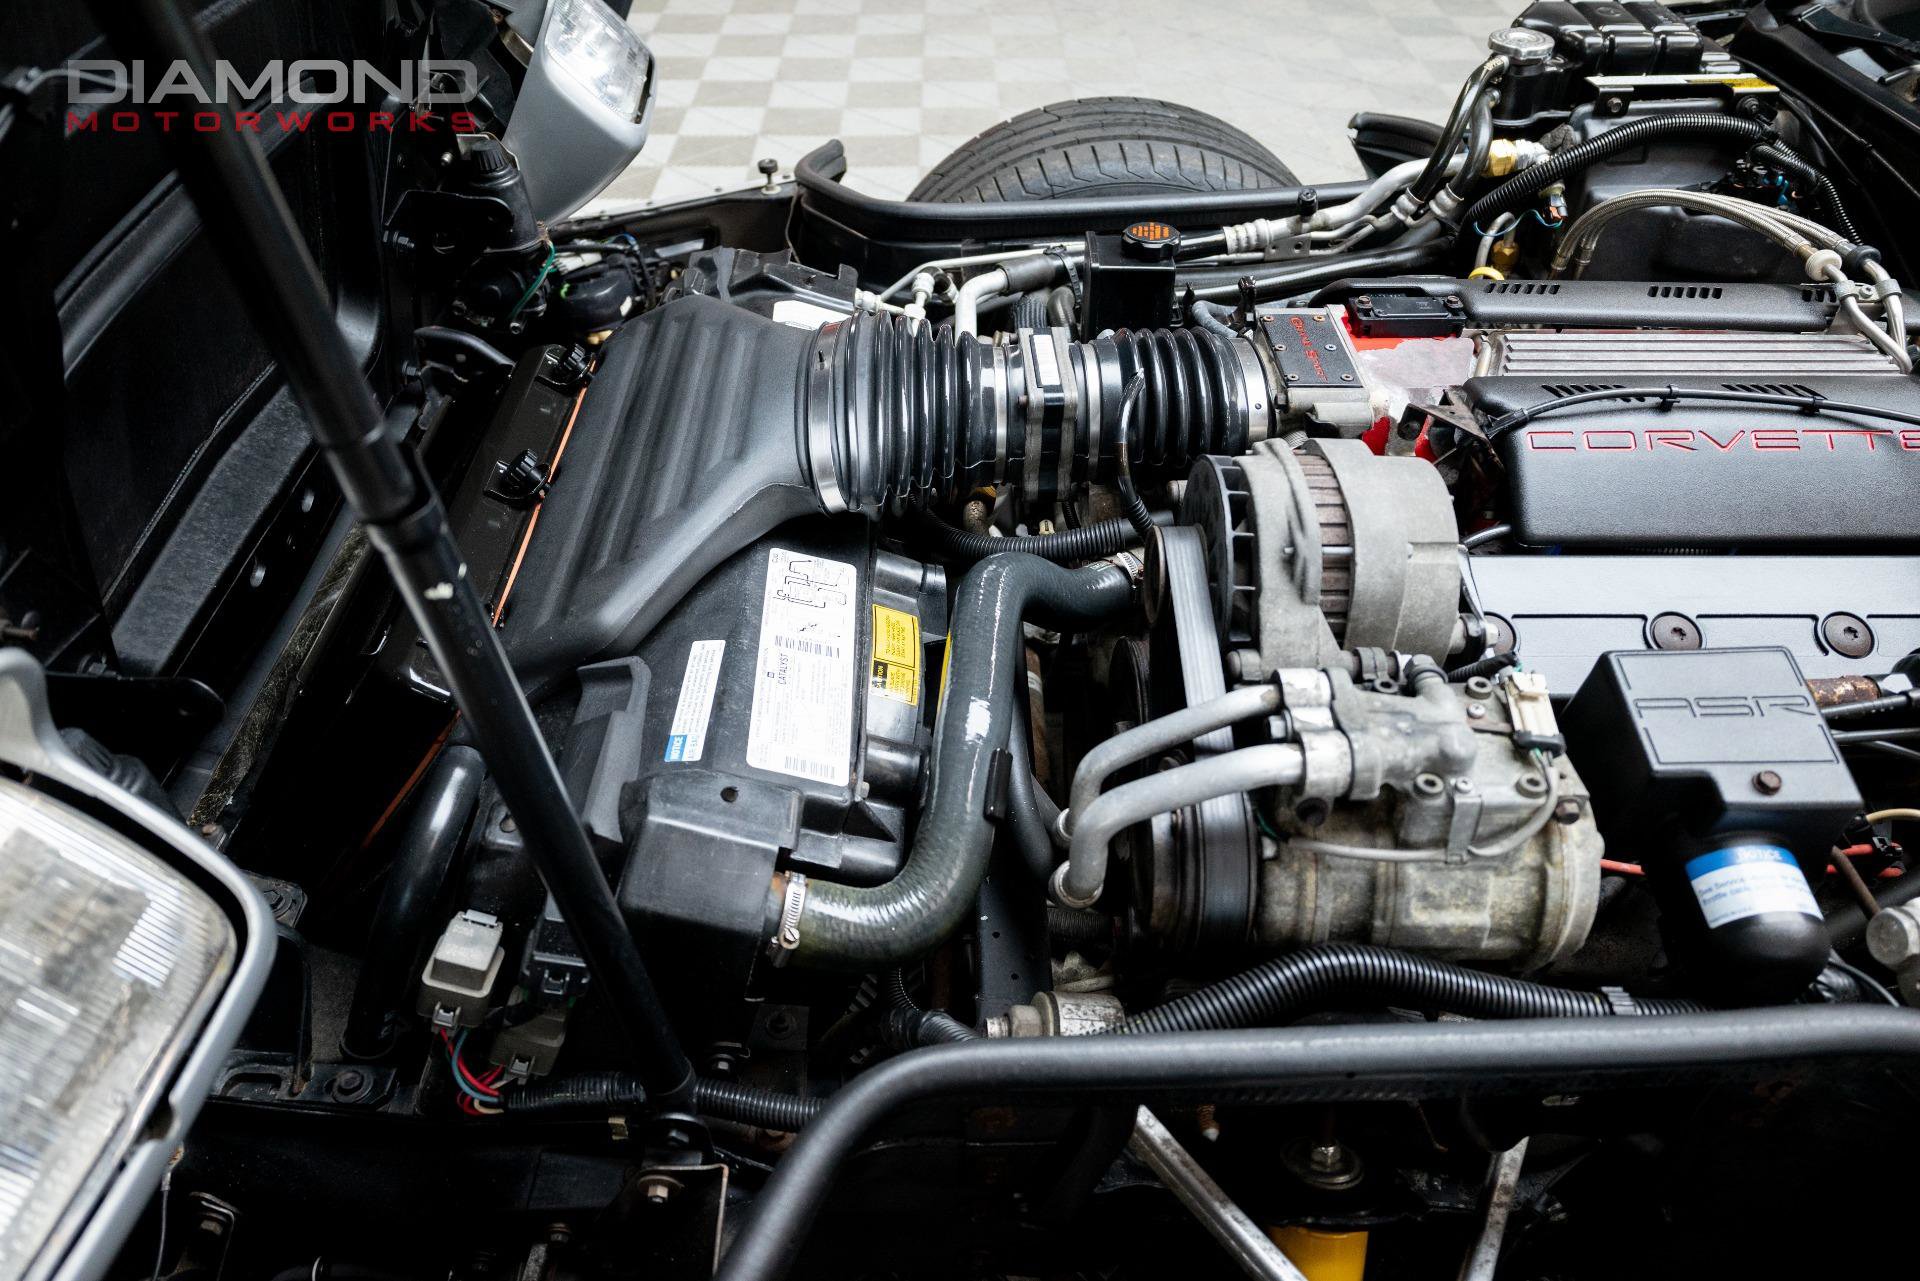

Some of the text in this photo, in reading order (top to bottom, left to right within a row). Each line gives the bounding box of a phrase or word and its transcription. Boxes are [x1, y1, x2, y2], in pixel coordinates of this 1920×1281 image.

[777, 653, 789, 685] CATALYST
[1633, 695, 1816, 718] ASR
[670, 735, 684, 760] NOTICE
